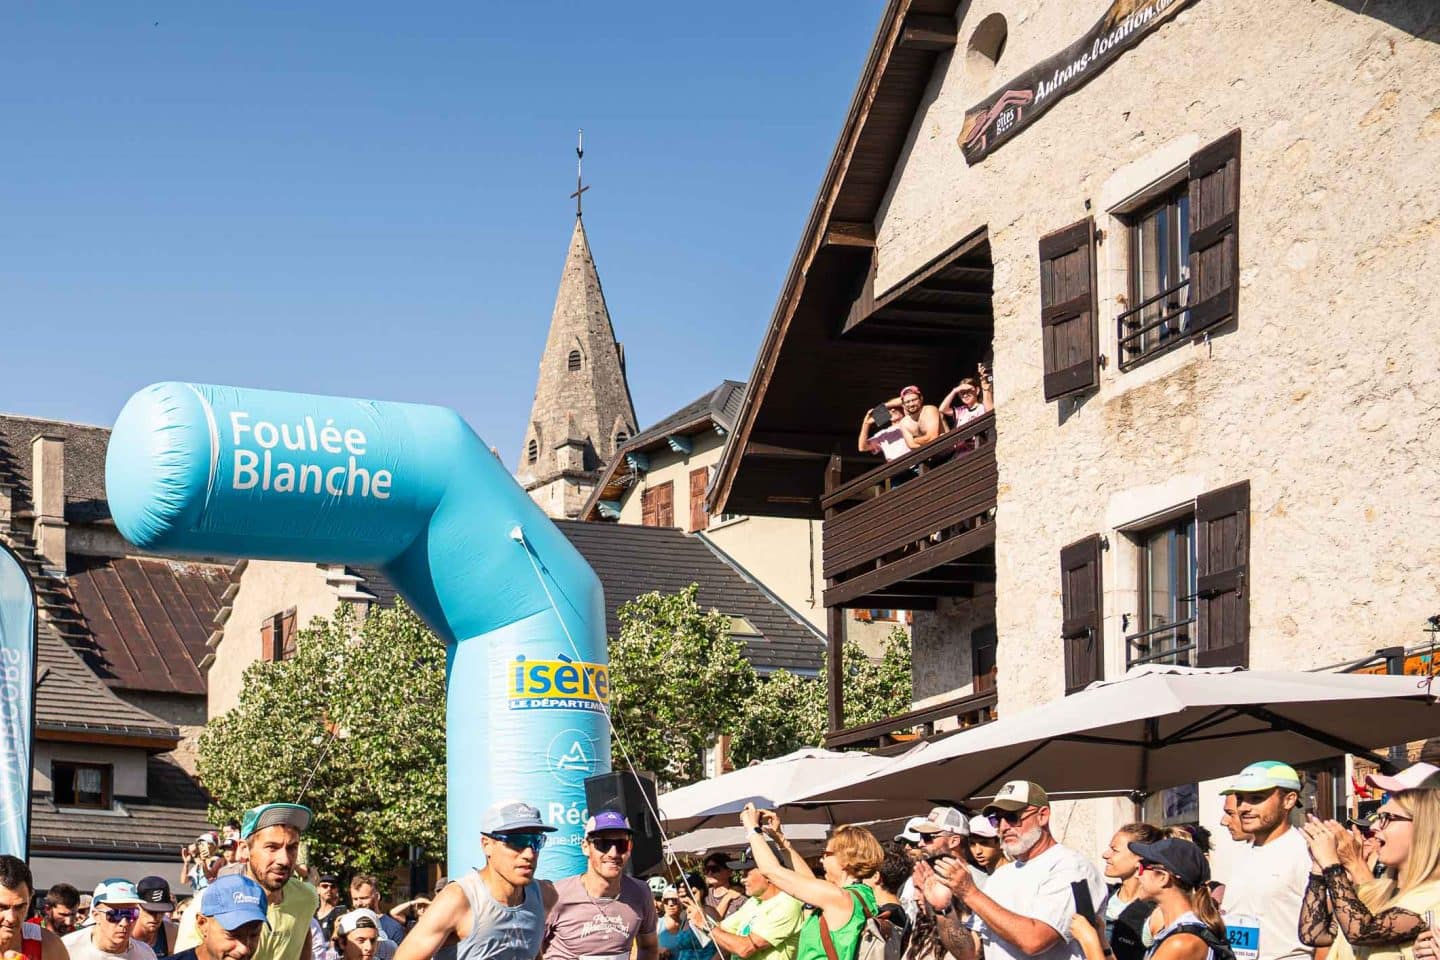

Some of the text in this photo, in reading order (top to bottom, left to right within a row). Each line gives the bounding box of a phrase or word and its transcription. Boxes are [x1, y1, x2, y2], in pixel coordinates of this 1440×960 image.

[229, 411, 368, 456] Foulée
[232, 449, 392, 499] Blanche
[515, 653, 607, 698] isère
